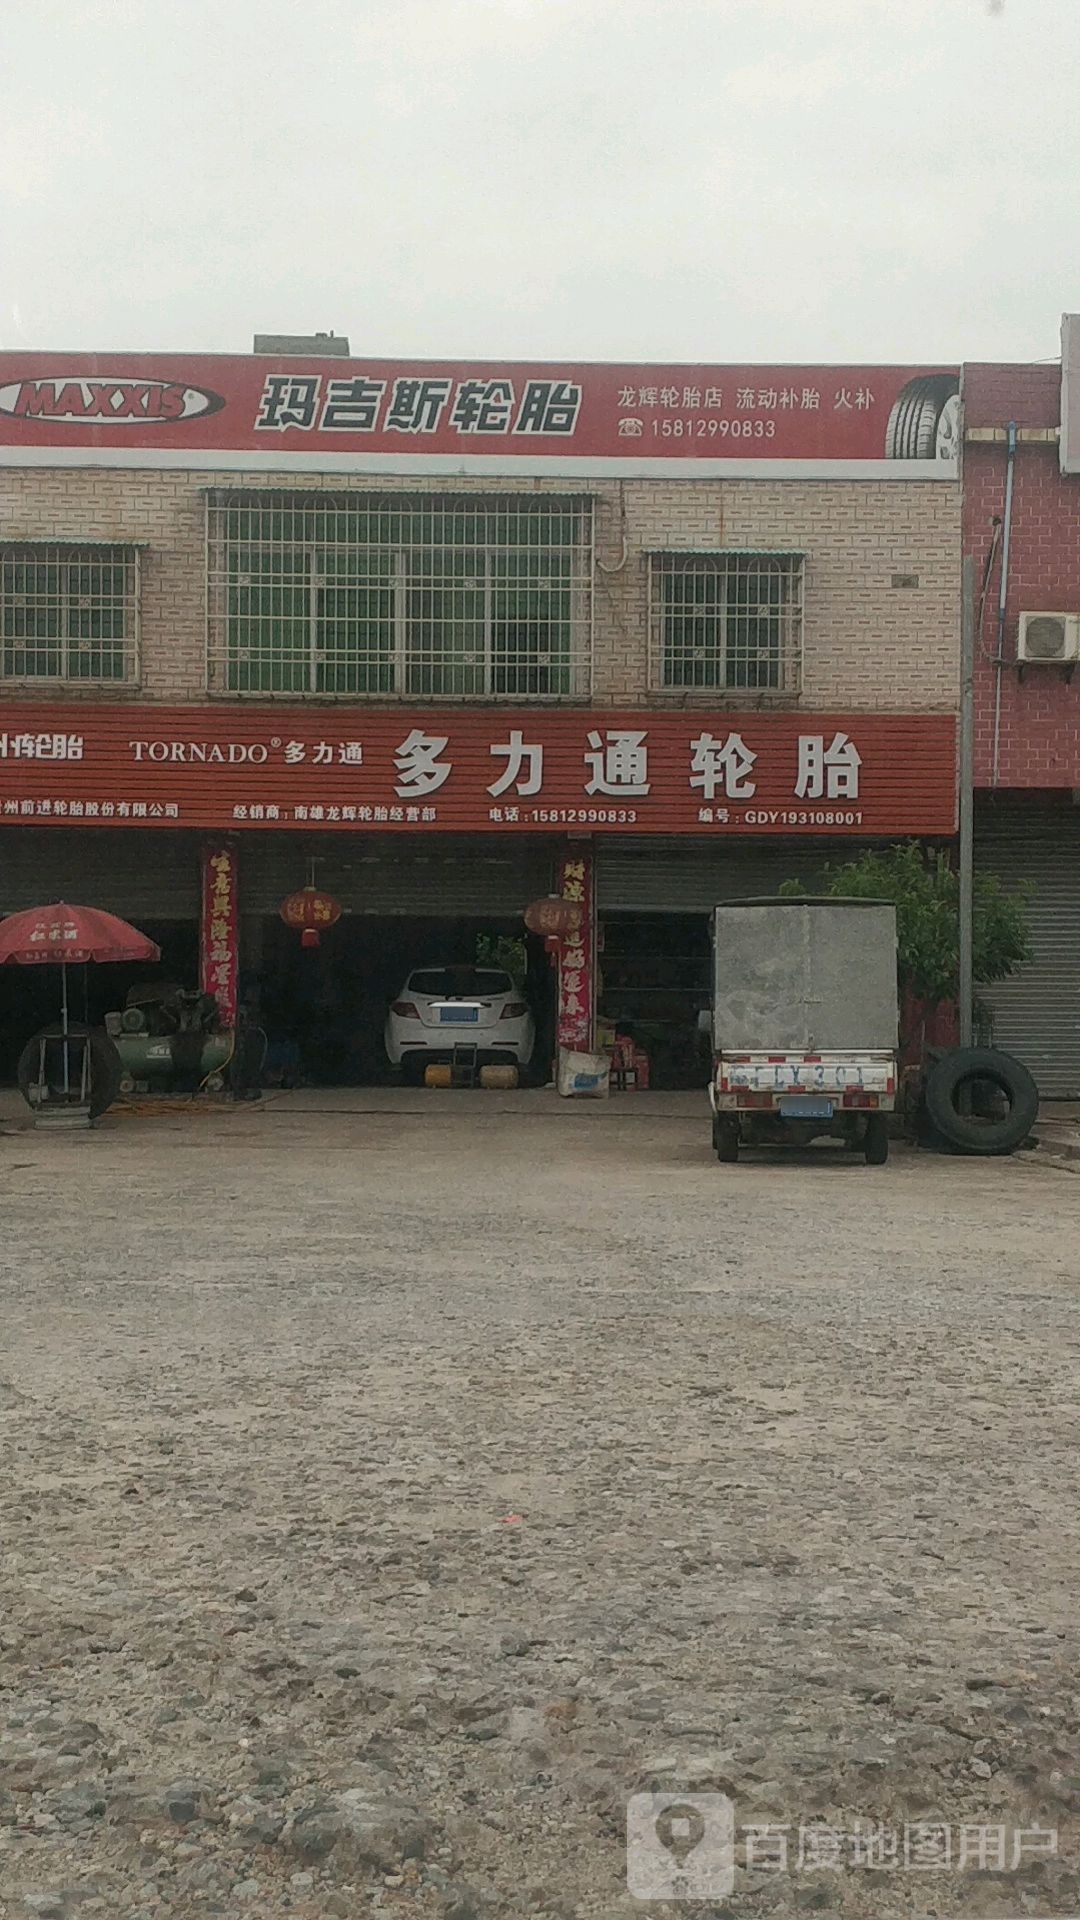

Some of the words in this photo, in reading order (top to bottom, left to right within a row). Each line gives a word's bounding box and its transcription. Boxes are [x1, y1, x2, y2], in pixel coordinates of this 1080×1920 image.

[253, 374, 584, 436] 玛吉斯轮胎
[617, 386, 723, 409] 龙辉轮胎店
[736, 387, 821, 410] 流动补胎
[833, 388, 876, 410] 火补
[651, 419, 776, 438] 15812990833
[0, 733, 84, 760] 轮胎
[284, 740, 363, 764] 多力通
[393, 729, 863, 799] 多力通轮胎
